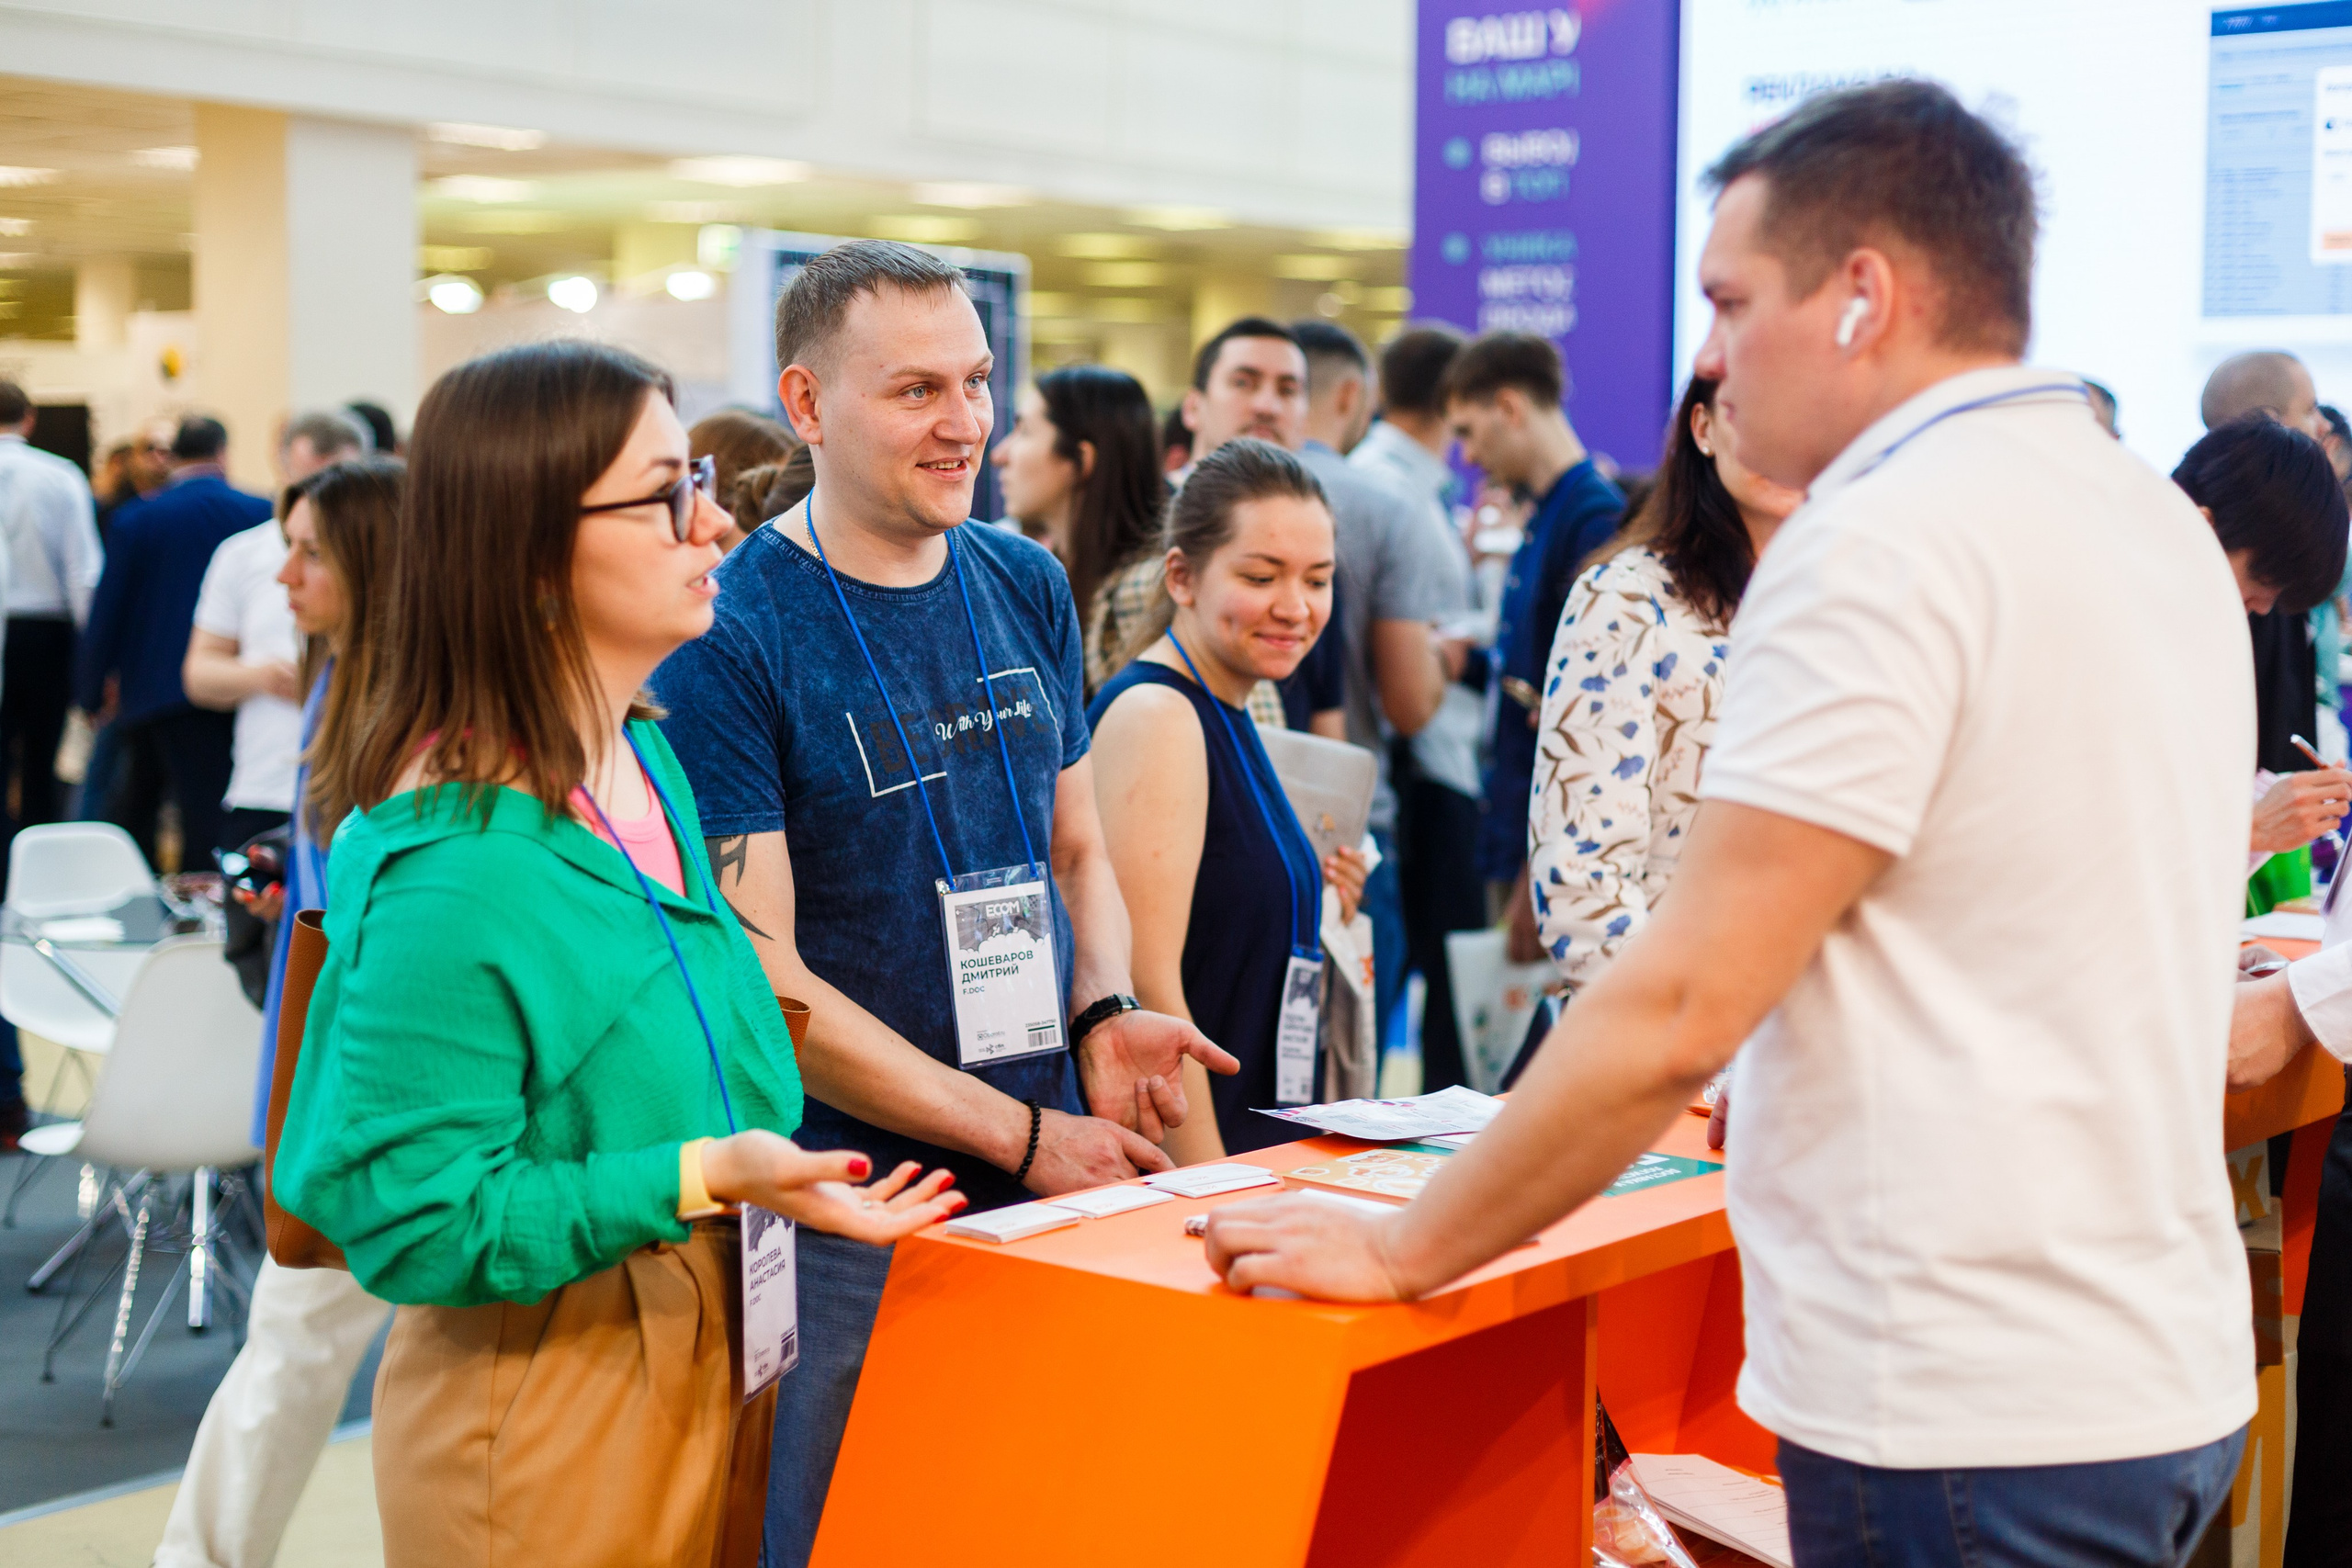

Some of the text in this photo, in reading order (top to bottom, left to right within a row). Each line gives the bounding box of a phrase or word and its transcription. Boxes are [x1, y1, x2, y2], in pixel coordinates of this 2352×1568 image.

[935, 715, 974, 740] With
[1014, 699, 1032, 718] Life
[985, 900, 1020, 918] ECOM
[960, 950, 1034, 969] КОШЕВАРОВ
[961, 964, 1019, 984] ДМИТРИЙ
[963, 986, 985, 995] F.DOC
[750, 1246, 782, 1276] КОРОЛЕВА
[750, 1259, 786, 1292] АНАСТАСИЯ
